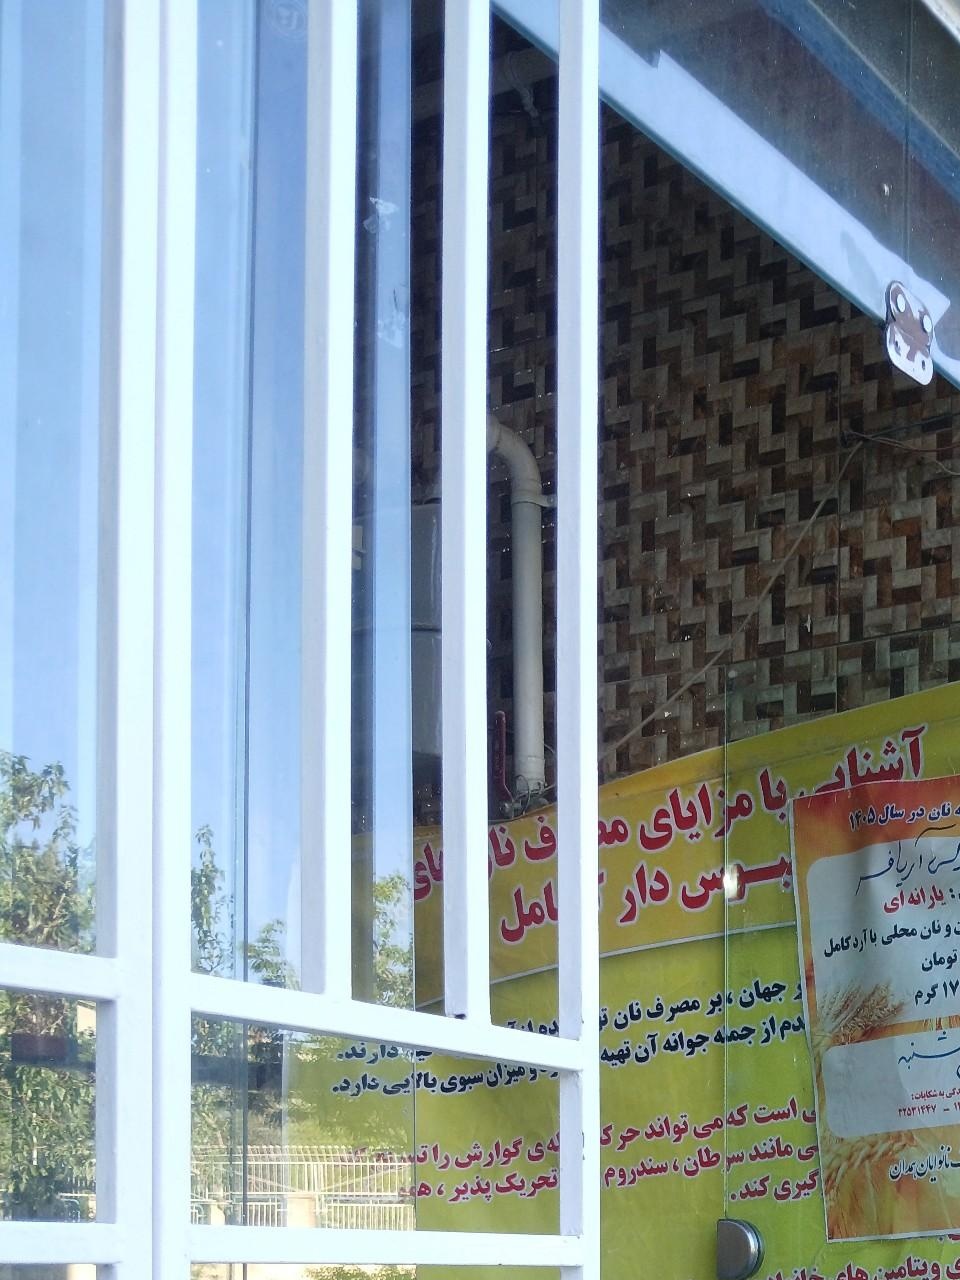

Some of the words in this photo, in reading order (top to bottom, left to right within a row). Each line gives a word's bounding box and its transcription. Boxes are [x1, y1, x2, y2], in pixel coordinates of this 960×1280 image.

[759, 769, 789, 820] با
[640, 783, 753, 850] مزایای
[878, 804, 904, 825] سال
[908, 807, 925, 823] در
[928, 803, 951, 821] نان
[620, 865, 670, 923] دار
[853, 928, 868, 954] آرد
[869, 929, 878, 945] با
[882, 924, 918, 946] محلی
[920, 920, 942, 940] نان
[944, 925, 952, 938] و
[823, 936, 851, 958] کامل
[921, 950, 958, 972] تومان
[913, 983, 939, 1006] گرم
[612, 1001, 643, 1030] نان
[646, 997, 701, 1023] مصرف
[760, 1016, 776, 1044] از
[600, 1041, 632, 1067] تهیه
[633, 1033, 657, 1063] آن
[662, 1031, 710, 1056] جوانه
[486, 1062, 526, 1088] میزان
[726, 1104, 749, 1127] که
[752, 1097, 798, 1125] است
[644, 1114, 690, 1143] تواند
[693, 1115, 724, 1140] می
[431, 1143, 451, 1170] را
[454, 1137, 524, 1169] گوارش
[749, 1136, 794, 1162] مانند
[495, 1168, 559, 1200] تحریک
[603, 1157, 670, 1188] سندروم
